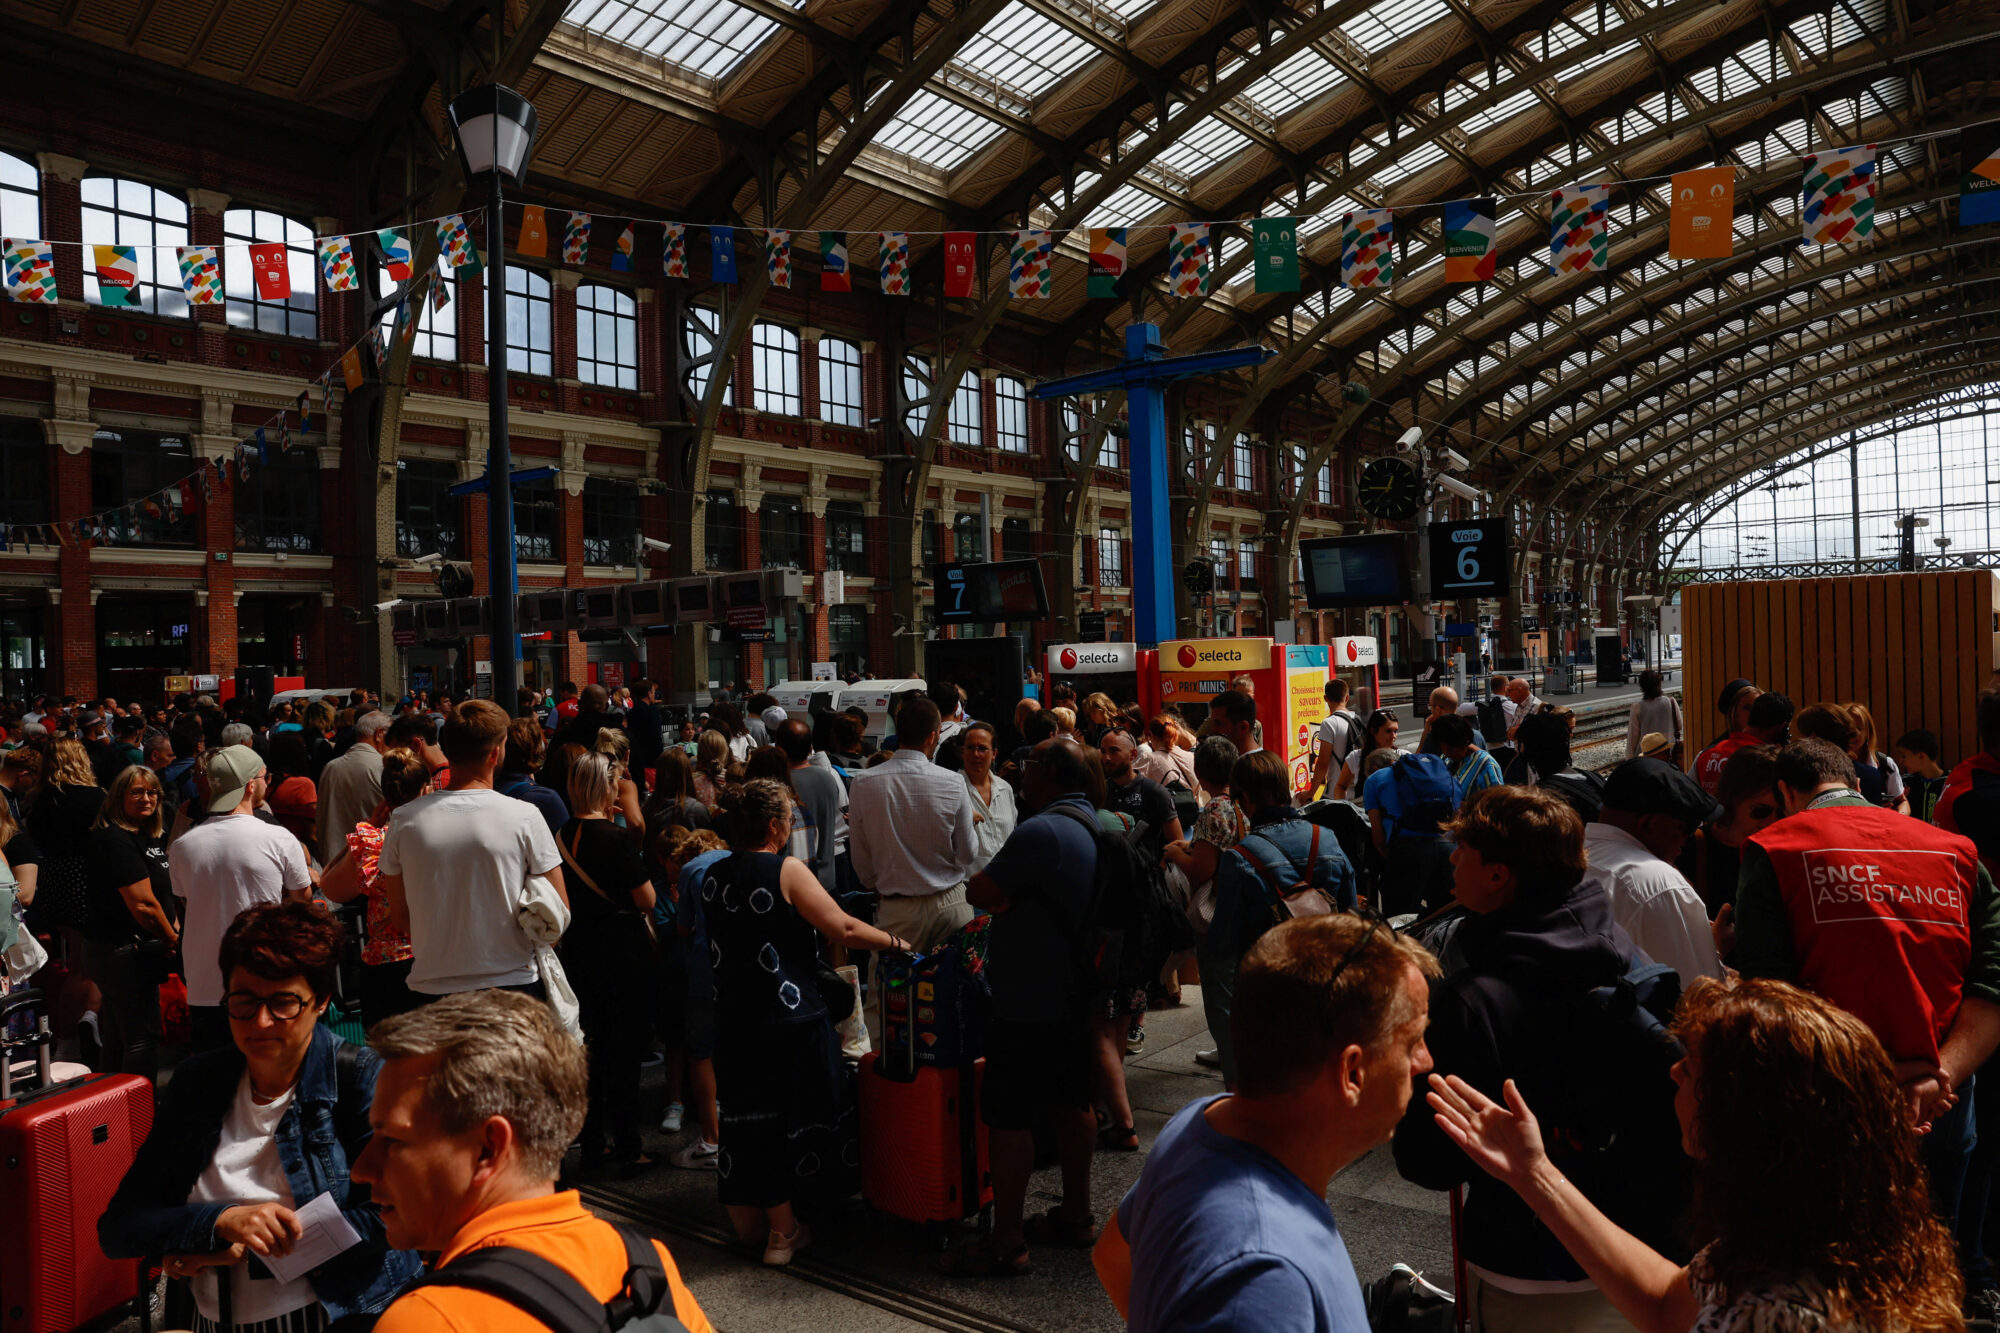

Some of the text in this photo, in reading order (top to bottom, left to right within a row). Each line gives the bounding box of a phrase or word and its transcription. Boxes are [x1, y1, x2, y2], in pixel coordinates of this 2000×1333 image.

[1969, 179, 2000, 189] WELC
[1449, 244, 1485, 253] BIENVENUE
[1455, 531, 1479, 541] Voie
[1457, 545, 1480, 581] 6
[950, 583, 965, 610] 7
[1198, 650, 1242, 662] selecta
[1358, 646, 1374, 656] selecta
[1078, 652, 1119, 664] selecta
[1161, 679, 1175, 696] ICI
[1178, 681, 1197, 693] PRIX
[1199, 680, 1226, 694] MINIS
[1299, 697, 1321, 706] saveurs
[1812, 864, 1881, 885] SNCF
[1816, 883, 1961, 909] ASSISTANCE
